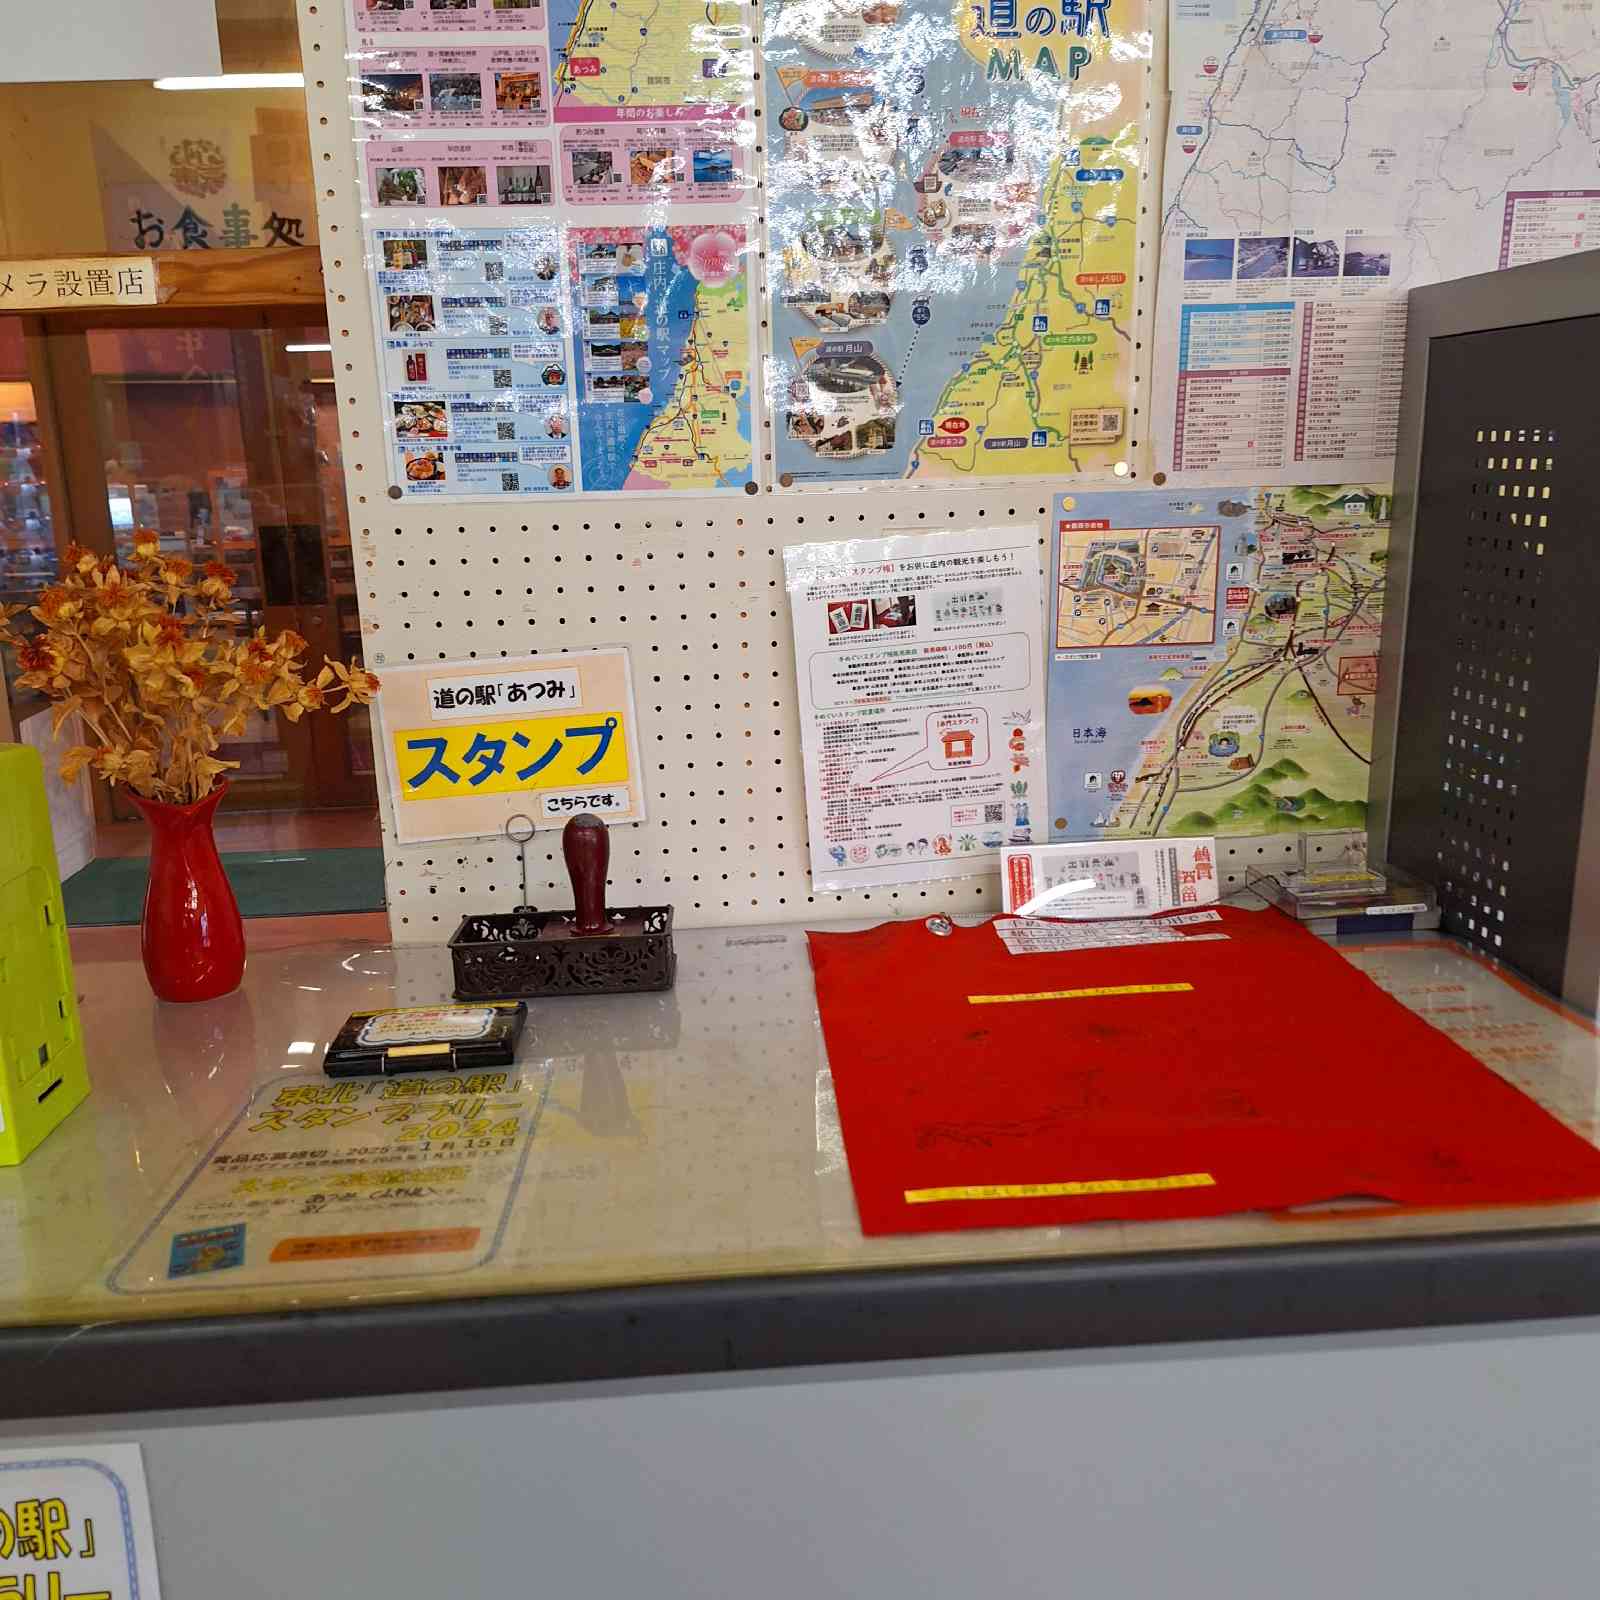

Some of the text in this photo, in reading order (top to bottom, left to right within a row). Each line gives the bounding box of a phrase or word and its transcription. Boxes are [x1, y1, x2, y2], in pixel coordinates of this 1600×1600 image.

[987, 46, 1092, 81] MAP
[129, 202, 305, 250] お食事処
[432, 679, 577, 710] 道の駅「あつみ」
[1071, 726, 1108, 739] 日本海
[407, 716, 618, 789] スタンプ
[546, 793, 621, 812] こちらです。
[272, 1072, 523, 1108] 東北「道の駅」
[248, 1097, 522, 1133] スタンプラリー
